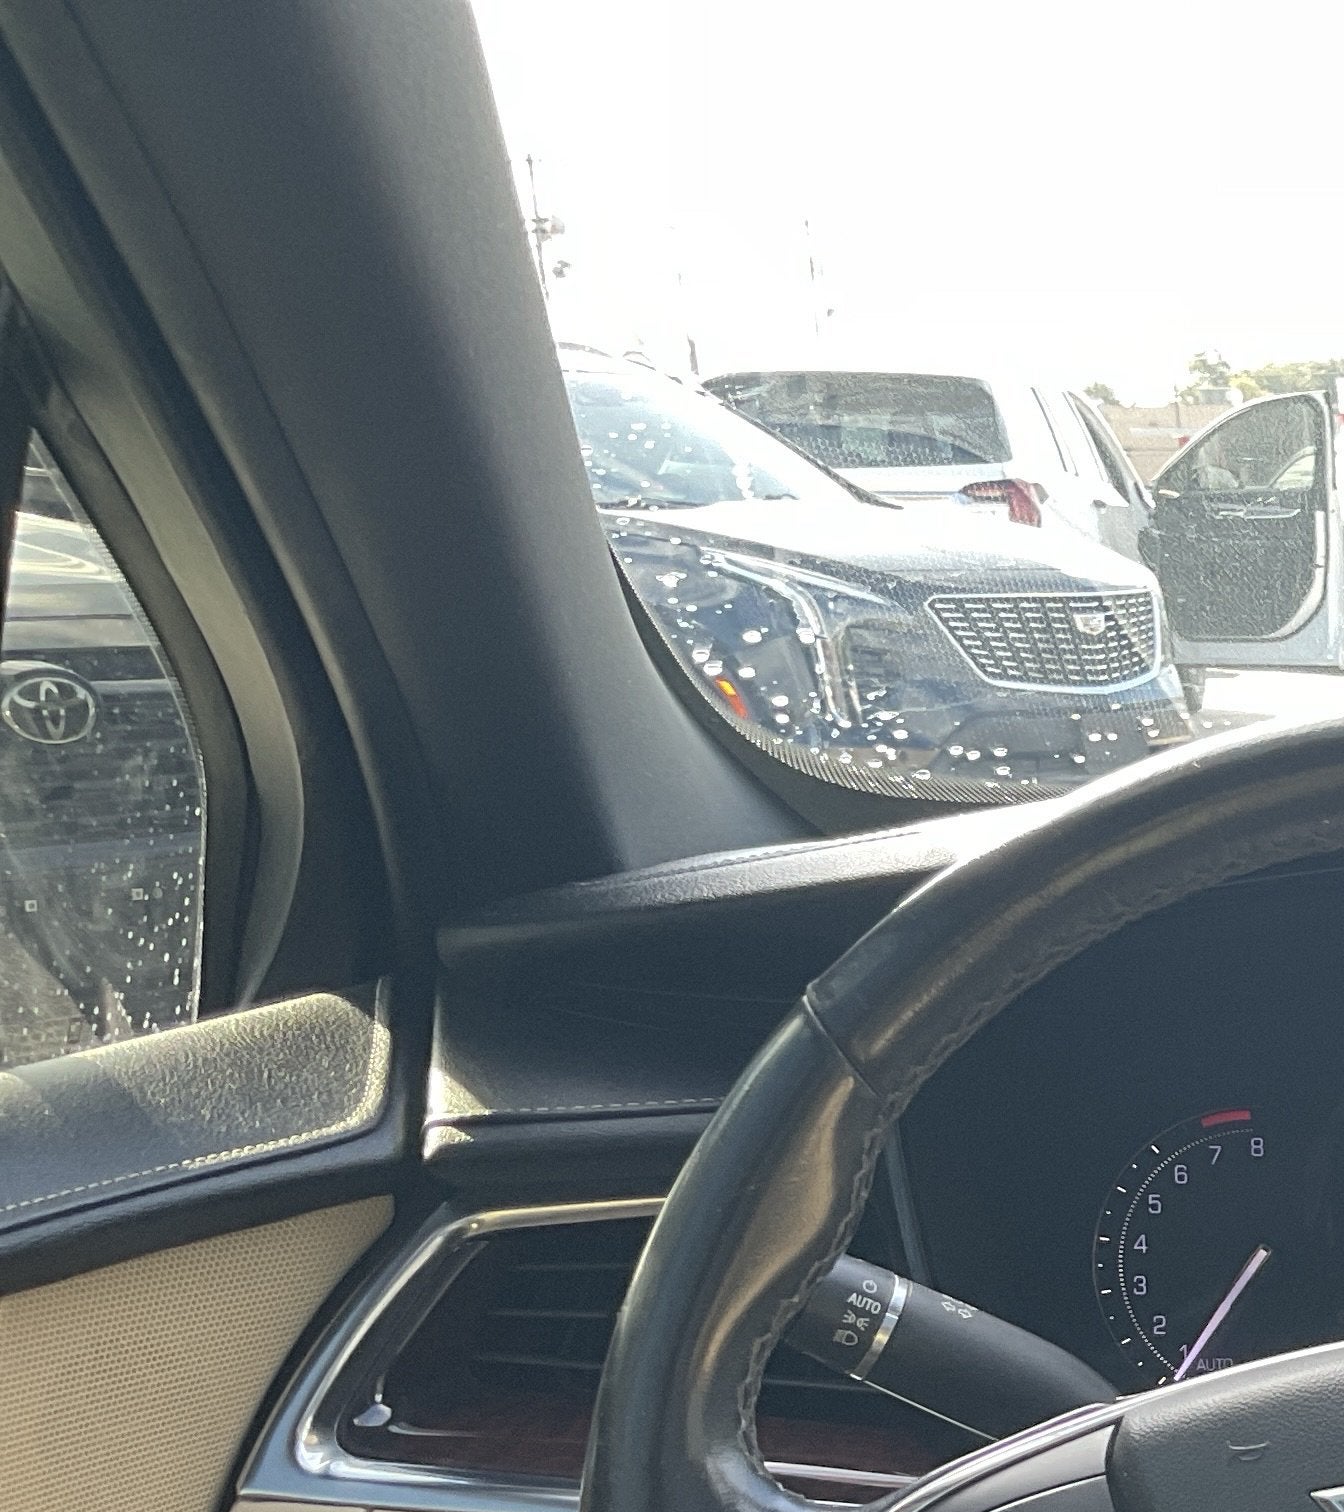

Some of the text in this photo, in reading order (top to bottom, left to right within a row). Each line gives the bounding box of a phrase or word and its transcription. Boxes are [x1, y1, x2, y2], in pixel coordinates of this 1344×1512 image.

[1208, 1145, 1222, 1165] 7
[1250, 1137, 1265, 1157] 8
[1174, 1164, 1189, 1185] 6
[1148, 1194, 1162, 1215] 5
[1133, 1233, 1149, 1254] 4
[1133, 1275, 1148, 1296] 3
[847, 1292, 882, 1316] AUTO
[1152, 1315, 1167, 1336] 2
[1196, 1357, 1234, 1372] AUTO
